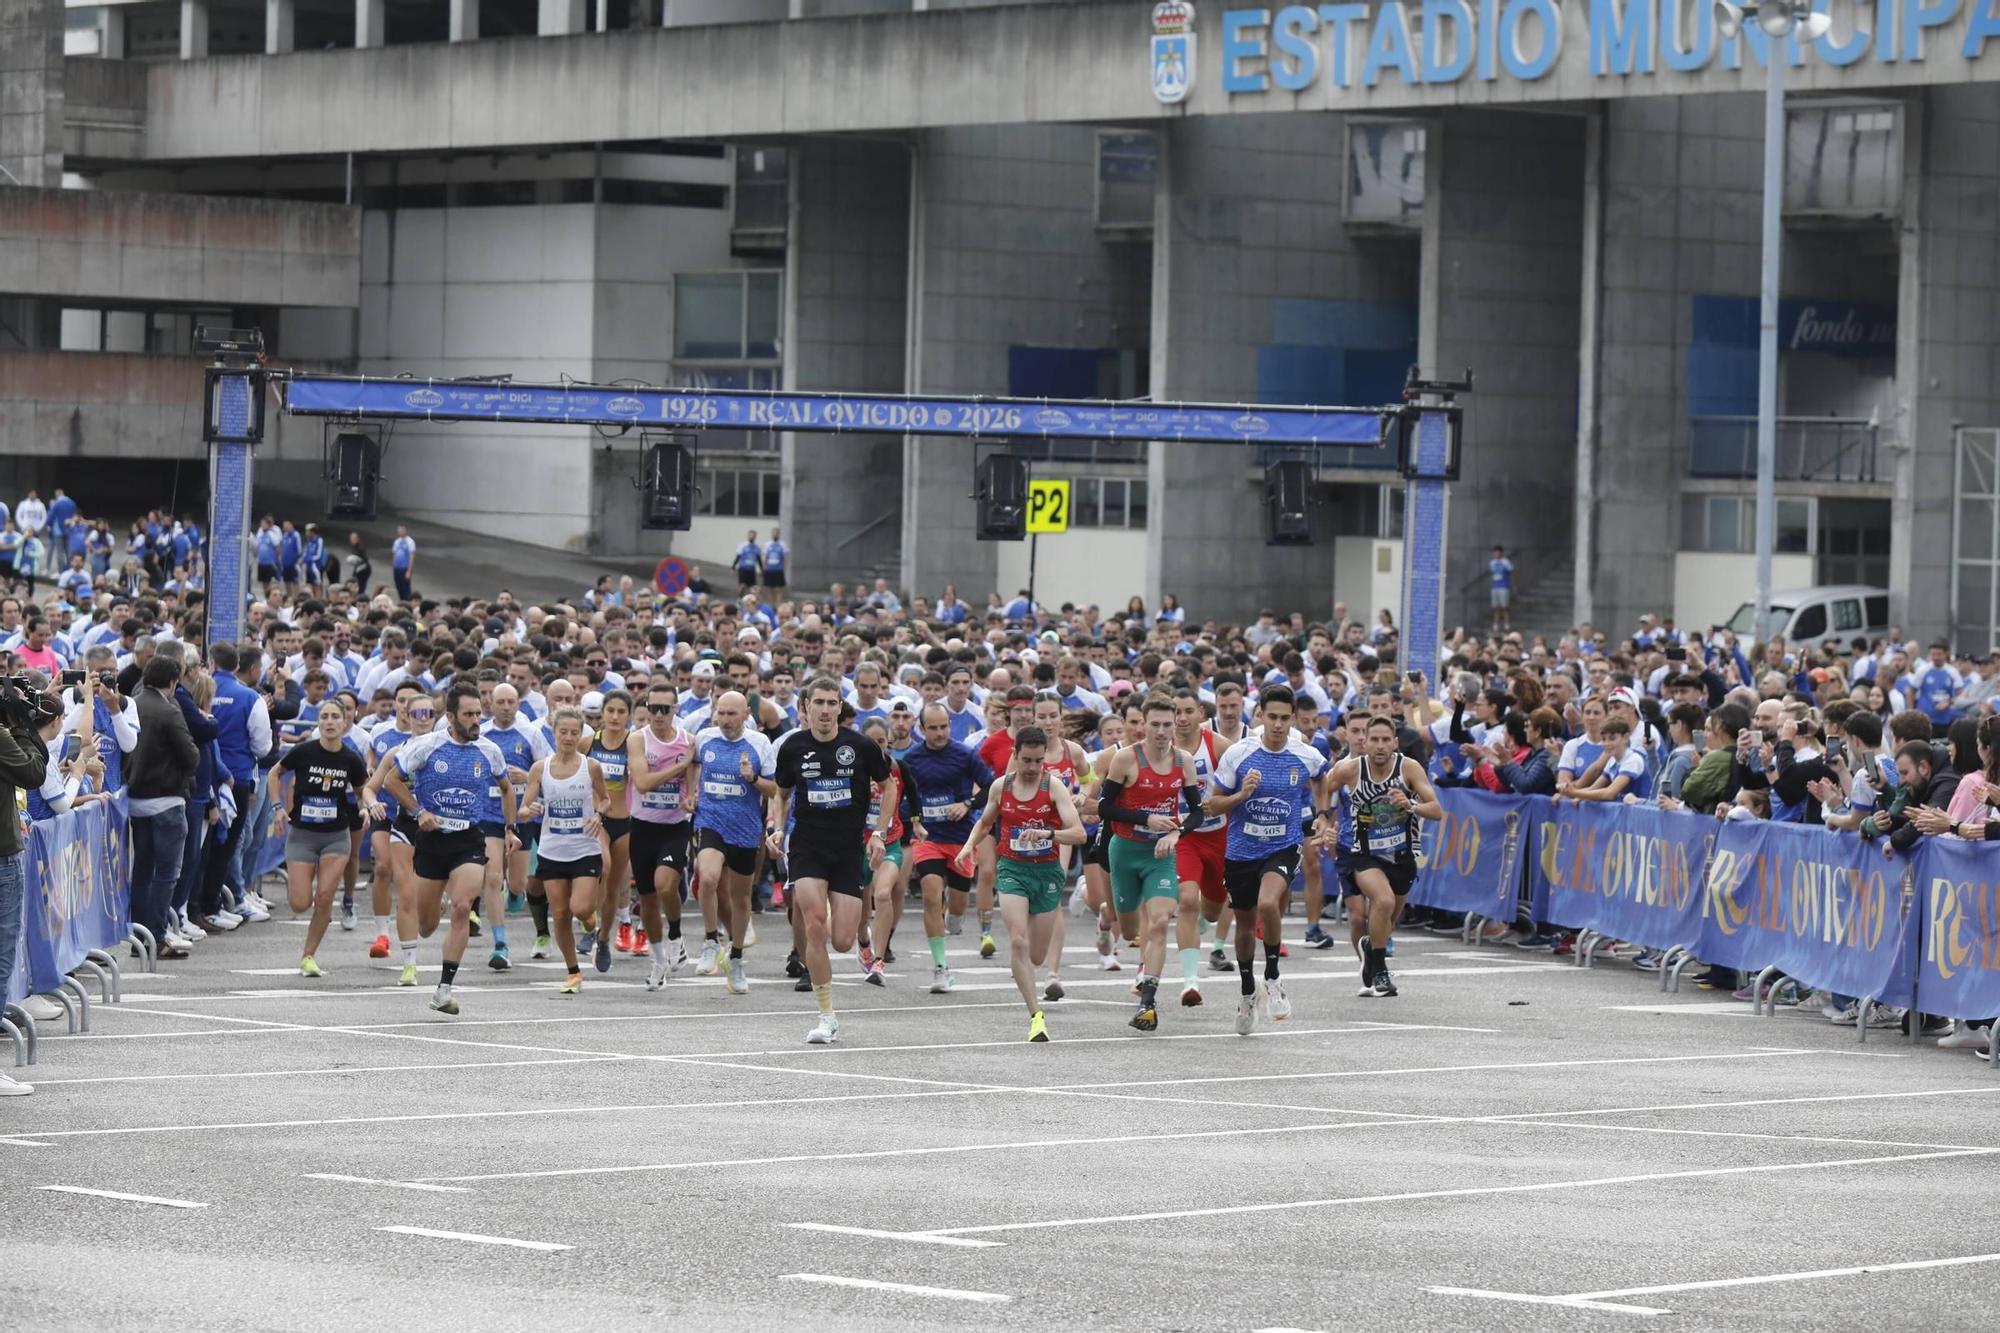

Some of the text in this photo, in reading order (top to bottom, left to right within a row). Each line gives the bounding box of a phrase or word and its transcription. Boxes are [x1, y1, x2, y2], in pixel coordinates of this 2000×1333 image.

[1222, 0, 1561, 91] ESTADIO
[1791, 305, 1863, 350] fondo
[509, 393, 532, 403] DIGI
[660, 398, 718, 419] 1926
[749, 400, 928, 427] REAL OVIEDO
[957, 406, 1022, 430] 2026
[1031, 487, 1064, 524] P2
[308, 776, 345, 788] 19 26
[1252, 813, 1279, 822] MARCHA
[1375, 825, 1400, 835] MARCHA
[1602, 830, 1690, 913] OVIEDO
[1791, 858, 1886, 952] OVIEDO
